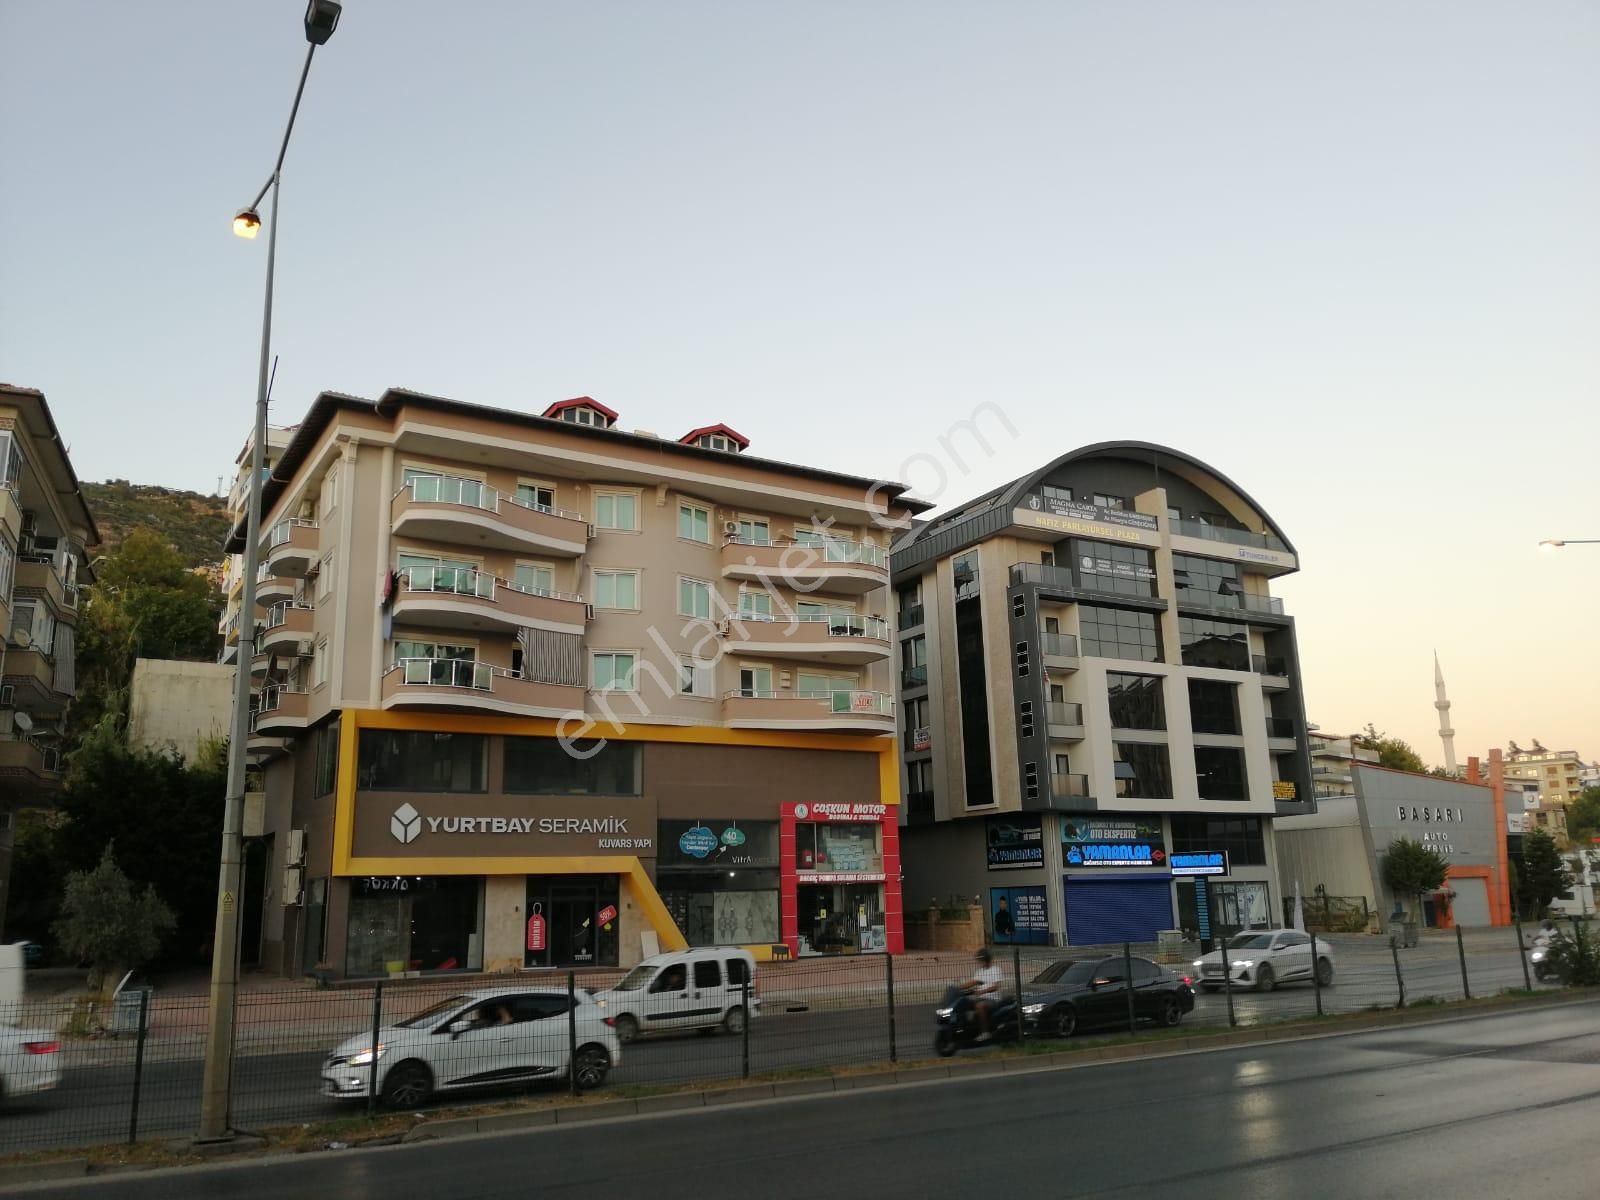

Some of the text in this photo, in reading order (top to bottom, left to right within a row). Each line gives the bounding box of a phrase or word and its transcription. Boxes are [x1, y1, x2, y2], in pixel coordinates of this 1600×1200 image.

[812, 803, 886, 815] COŞKUN MOTOR
[427, 815, 628, 834] YURTBAY SERAMİK
[598, 838, 651, 848] KUVARS YAPI
[1081, 845, 1151, 860] YAMANLAR
